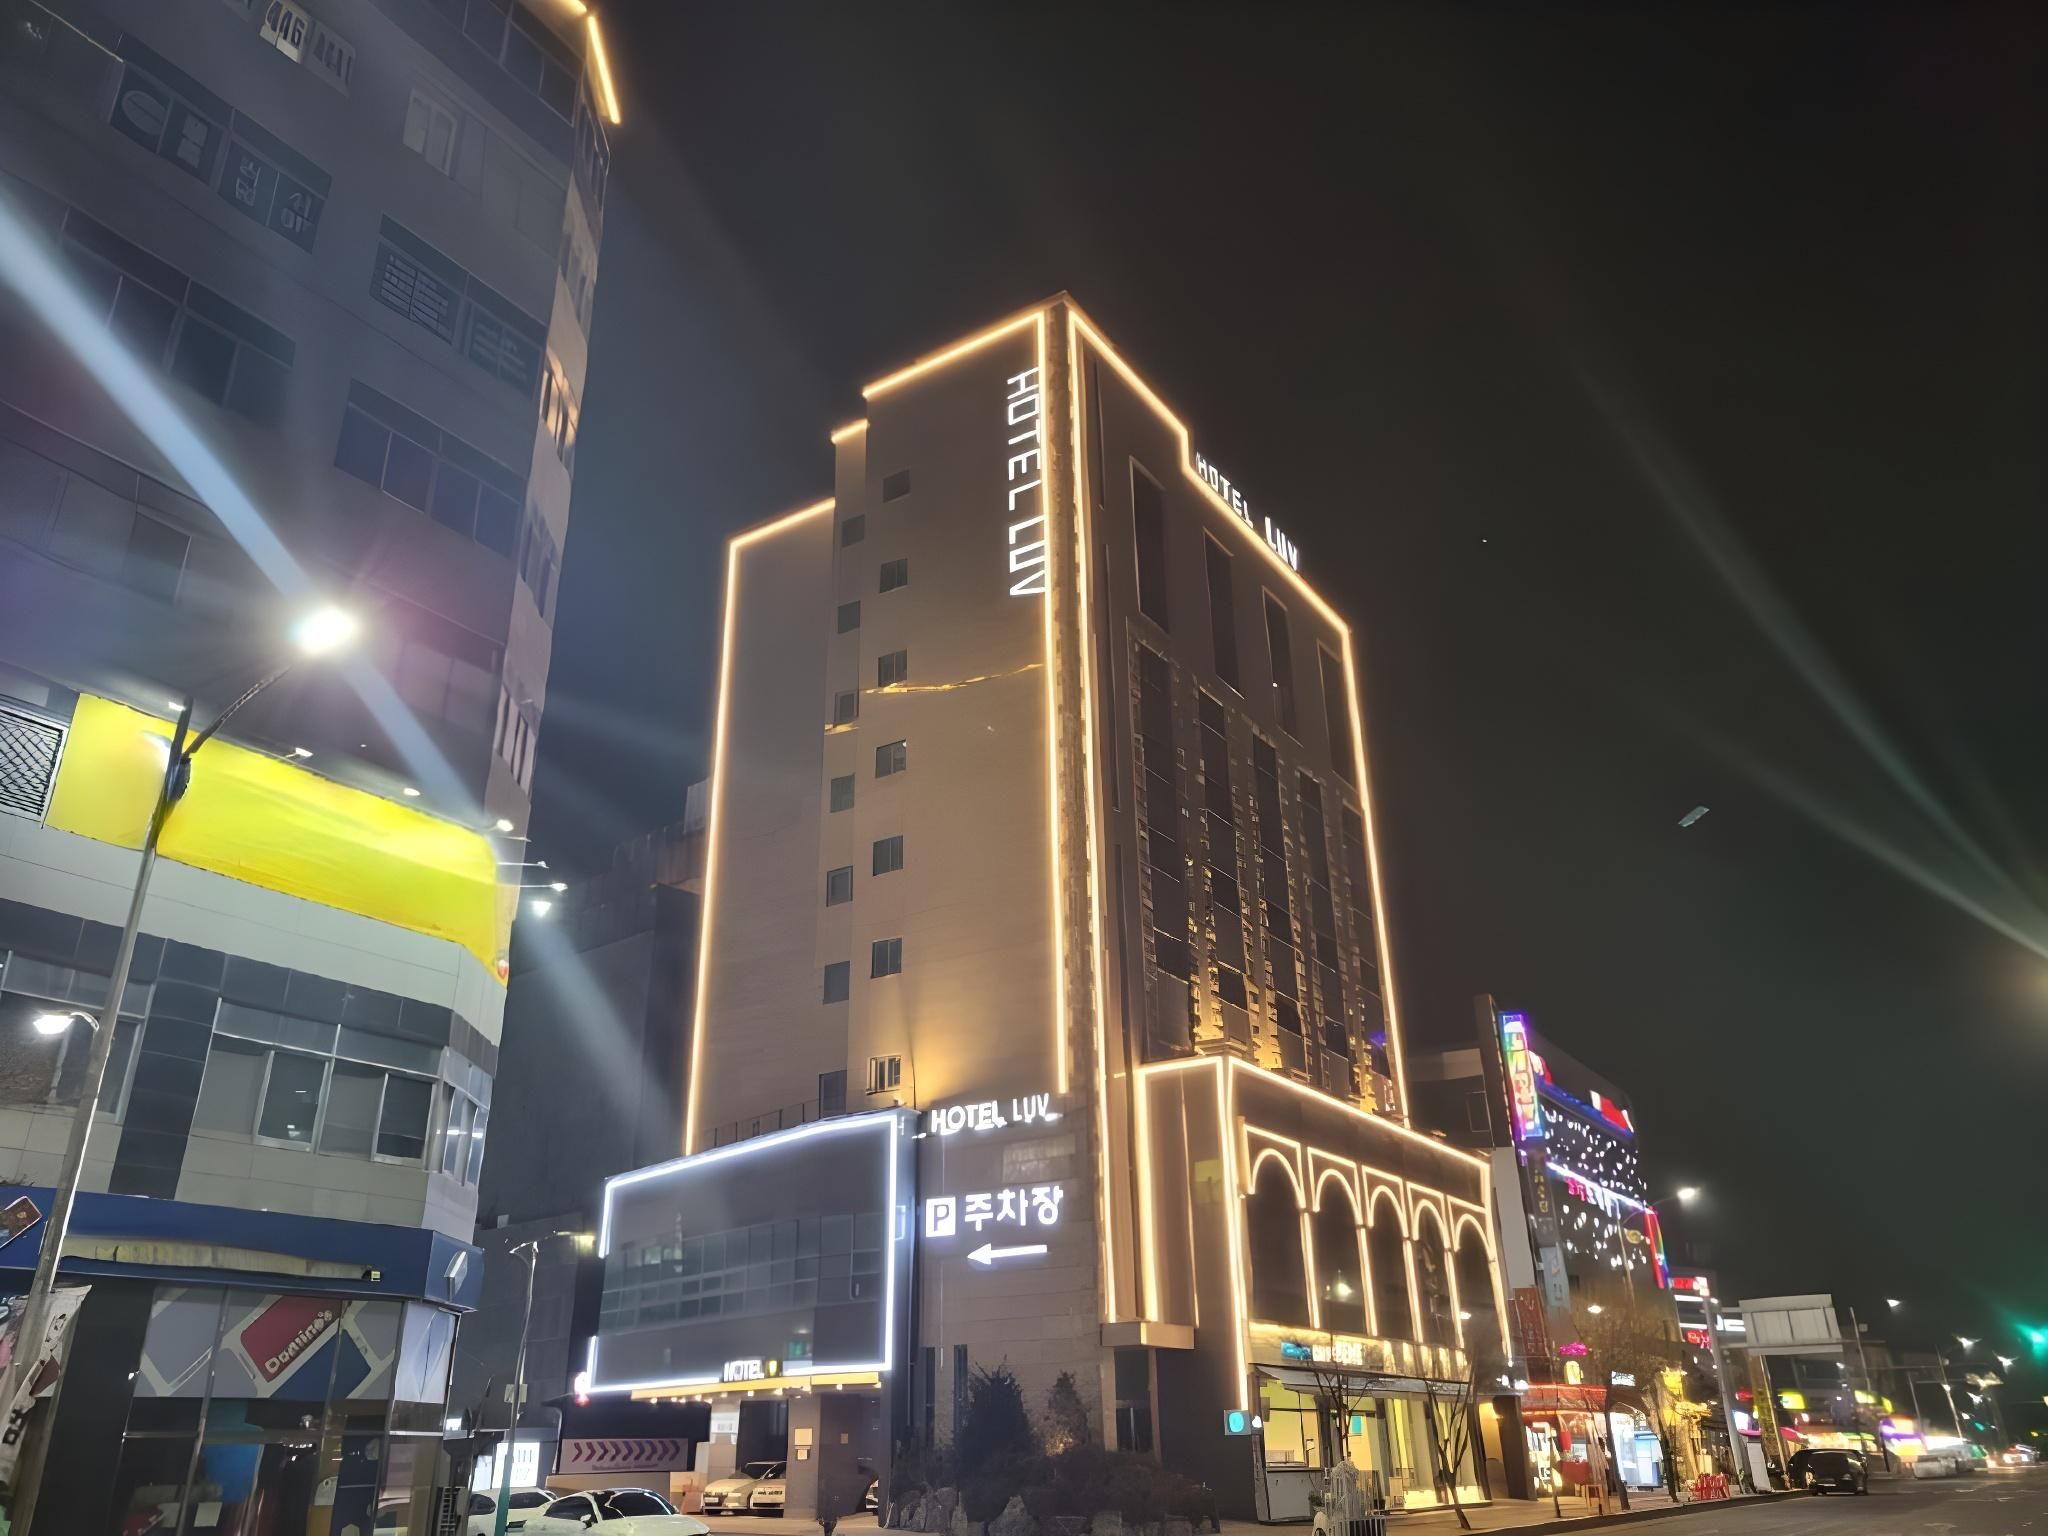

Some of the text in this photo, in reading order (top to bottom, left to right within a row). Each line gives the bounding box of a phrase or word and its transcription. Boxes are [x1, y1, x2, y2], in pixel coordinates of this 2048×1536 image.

[1007, 366, 1047, 596] HOTEL LUV
[1195, 451, 1298, 572] HOTEL LUV
[931, 1092, 1050, 1136] HOTEL LUV
[964, 1185, 1064, 1232] 주차장
[722, 1358, 765, 1383] HOTEL
